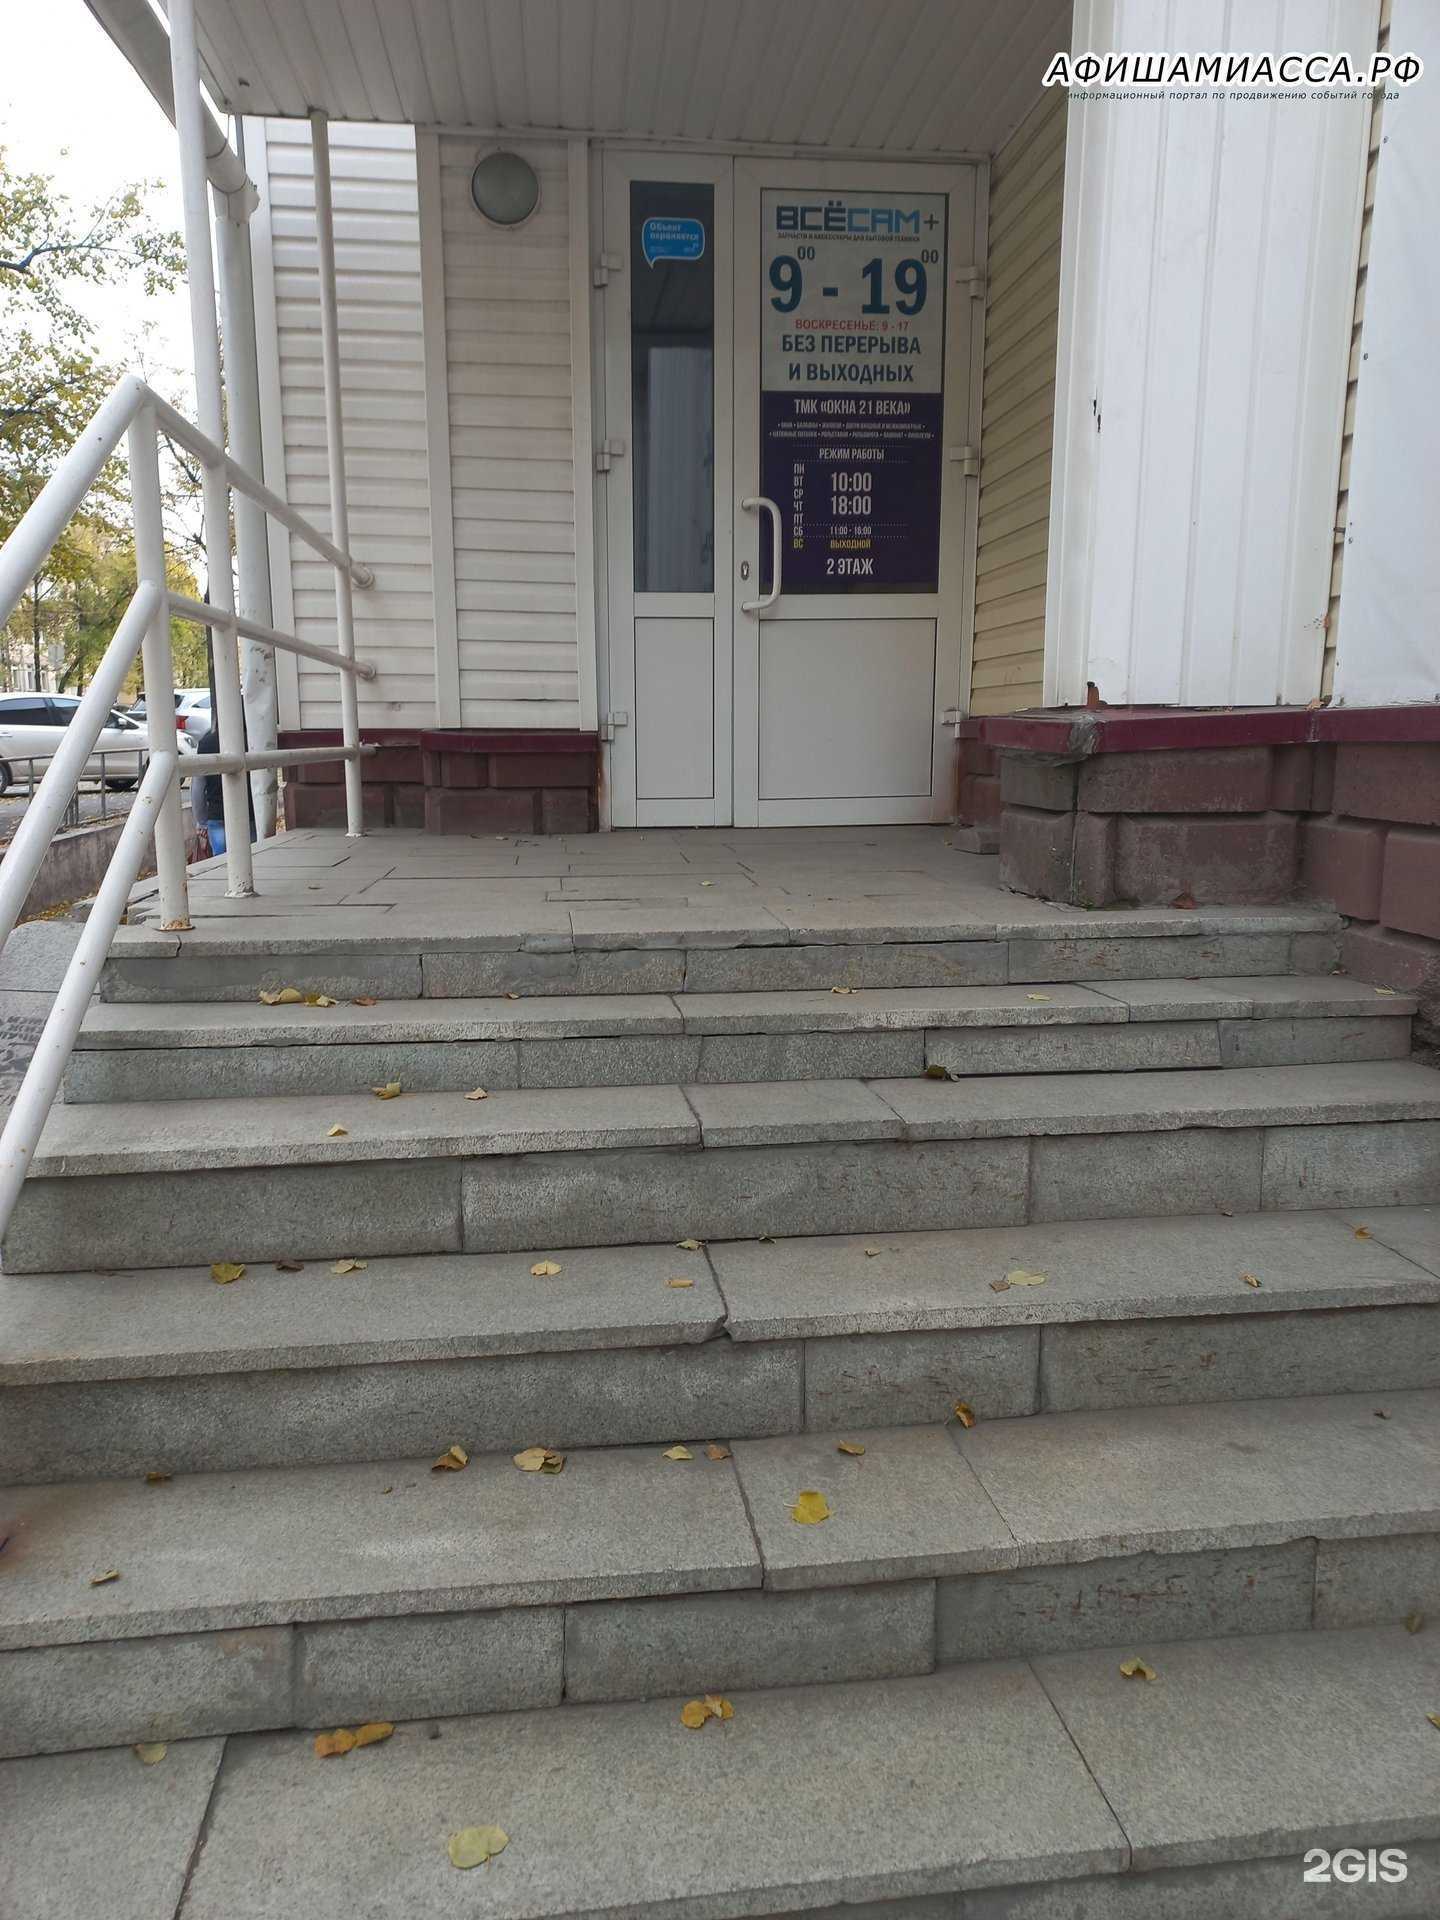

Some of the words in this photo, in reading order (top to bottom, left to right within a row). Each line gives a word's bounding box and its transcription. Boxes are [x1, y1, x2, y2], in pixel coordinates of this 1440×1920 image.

[769, 255, 802, 313] 9
[797, 246, 815, 261] 00
[862, 258, 927, 316] 19
[921, 249, 939, 264] 00
[782, 335, 816, 352] БЕЗ
[821, 335, 921, 354] ПЕРЕРЫВА
[789, 363, 800, 380] И
[806, 363, 914, 384] ВЫХОДНЫХ
[794, 399, 818, 414] ТМК
[859, 400, 873, 415] 21
[819, 448, 850, 460] РЕЖИМ
[851, 448, 885, 460] РАБОТЫ
[793, 463, 805, 474] ПН
[793, 476, 804, 487] ВТ
[831, 472, 872, 492] 10:00
[793, 488, 804, 500] СР
[793, 501, 804, 512] ЧТ
[831, 495, 872, 515] 18:00
[793, 513, 804, 525] ПТ
[793, 526, 804, 537] СБ
[793, 538, 804, 549] ВС
[830, 538, 871, 550] ВЫХОДНОЙ
[826, 558, 835, 575] 2
[837, 558, 874, 575] ЭТАЖ
